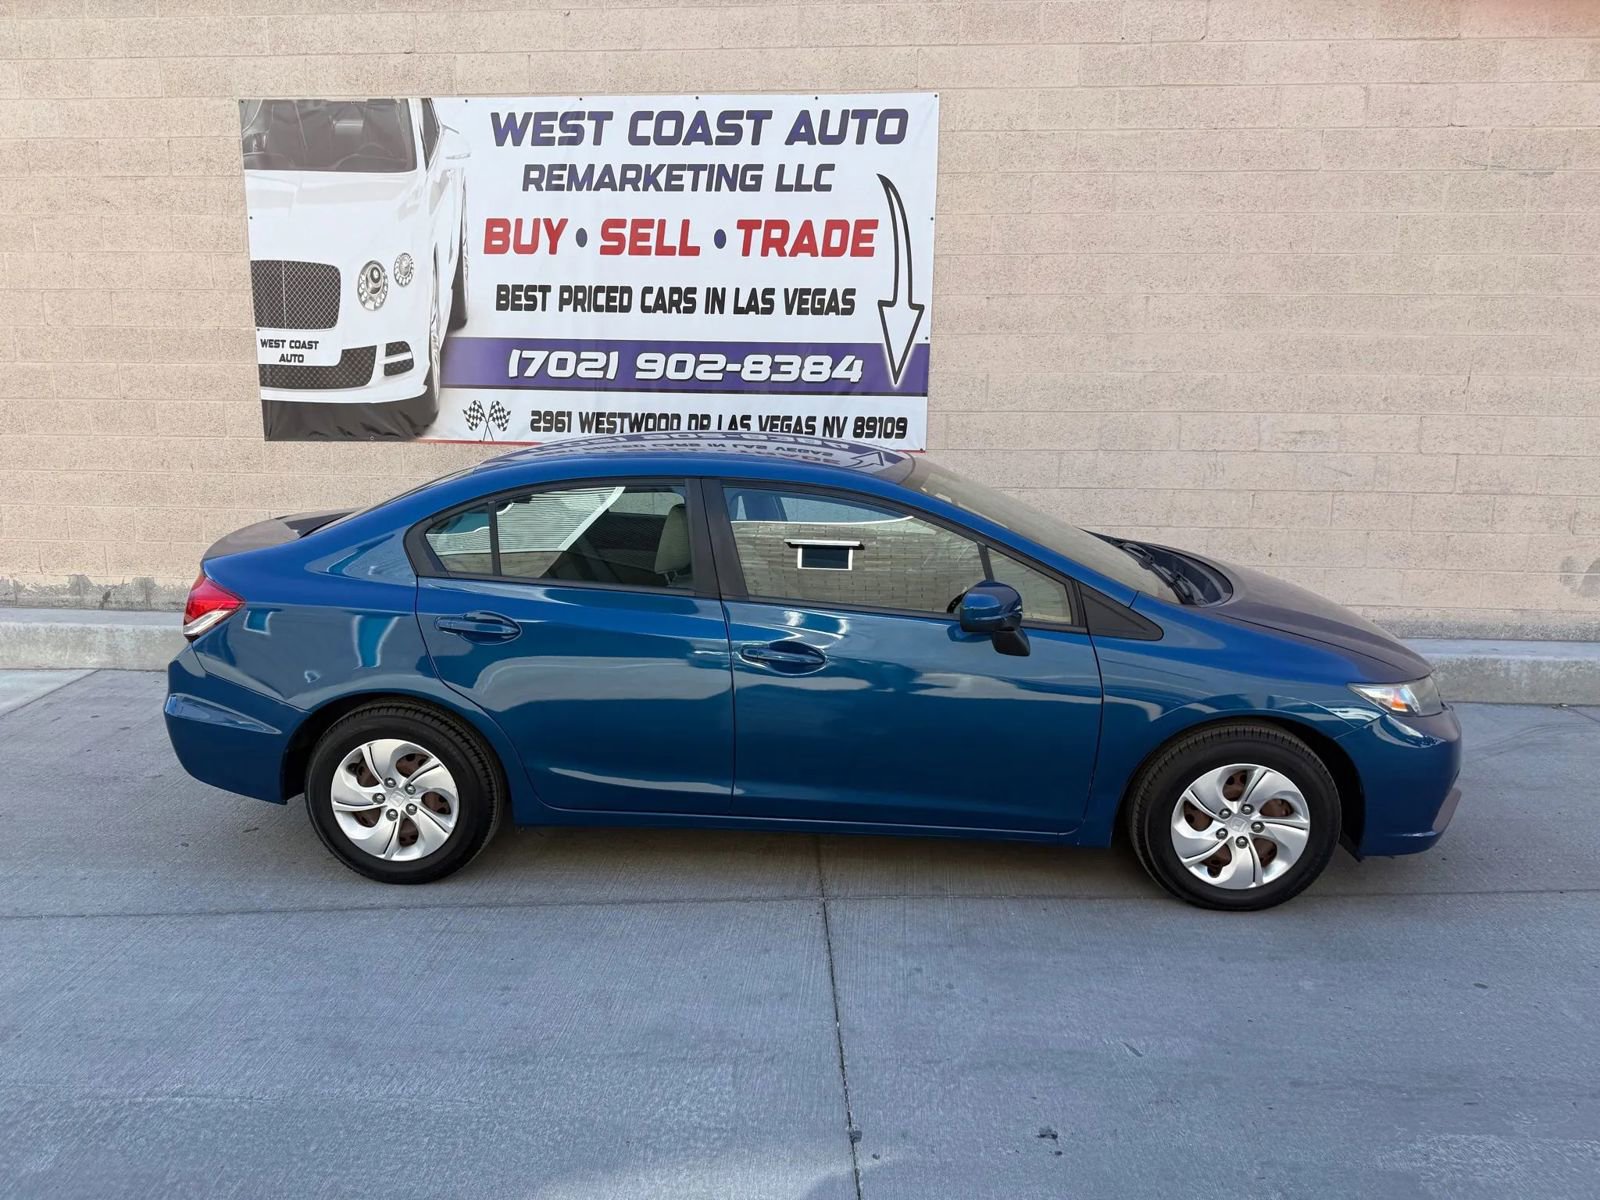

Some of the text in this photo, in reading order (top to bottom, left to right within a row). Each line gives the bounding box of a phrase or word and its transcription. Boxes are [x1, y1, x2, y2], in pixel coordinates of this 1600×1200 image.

[491, 109, 908, 147] WEST COAST AUTO
[522, 163, 835, 193] REMARKETING LLC
[484, 218, 878, 258] BUY SELL TRADE
[495, 284, 857, 316] BEST PRICED CARS IN LAS VEGAS
[260, 339, 320, 350] WEST COAST
[279, 353, 305, 363] AUTO
[507, 349, 864, 383] (702) 902-8384
[530, 410, 573, 433] 2961
[579, 411, 681, 434] WESTWOOD
[758, 415, 817, 437] VEGAS
[822, 416, 849, 439] NV
[853, 416, 909, 440] 89109
